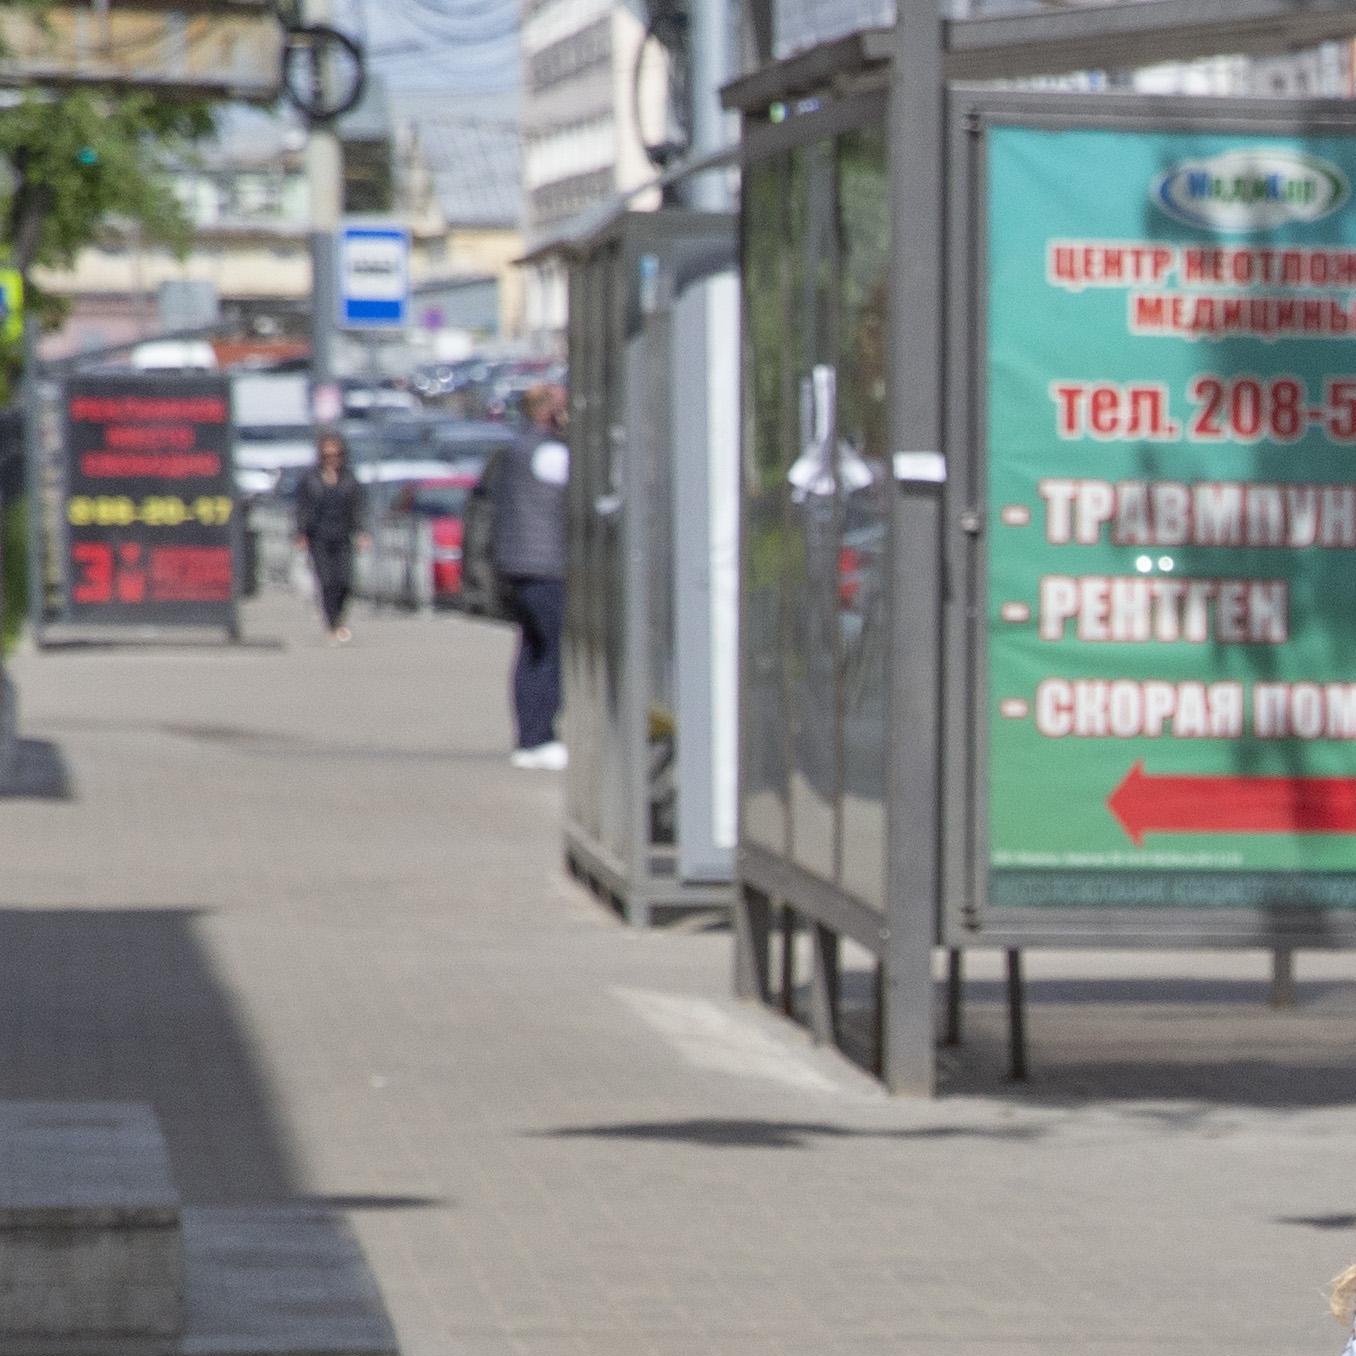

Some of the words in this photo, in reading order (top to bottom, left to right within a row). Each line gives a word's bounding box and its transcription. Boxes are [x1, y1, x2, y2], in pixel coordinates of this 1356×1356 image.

[1051, 243, 1174, 290] ЦЕНТР
[1038, 575, 1290, 643] РЕНТГЕН
[1036, 678, 1246, 739] СКОРАЯ
